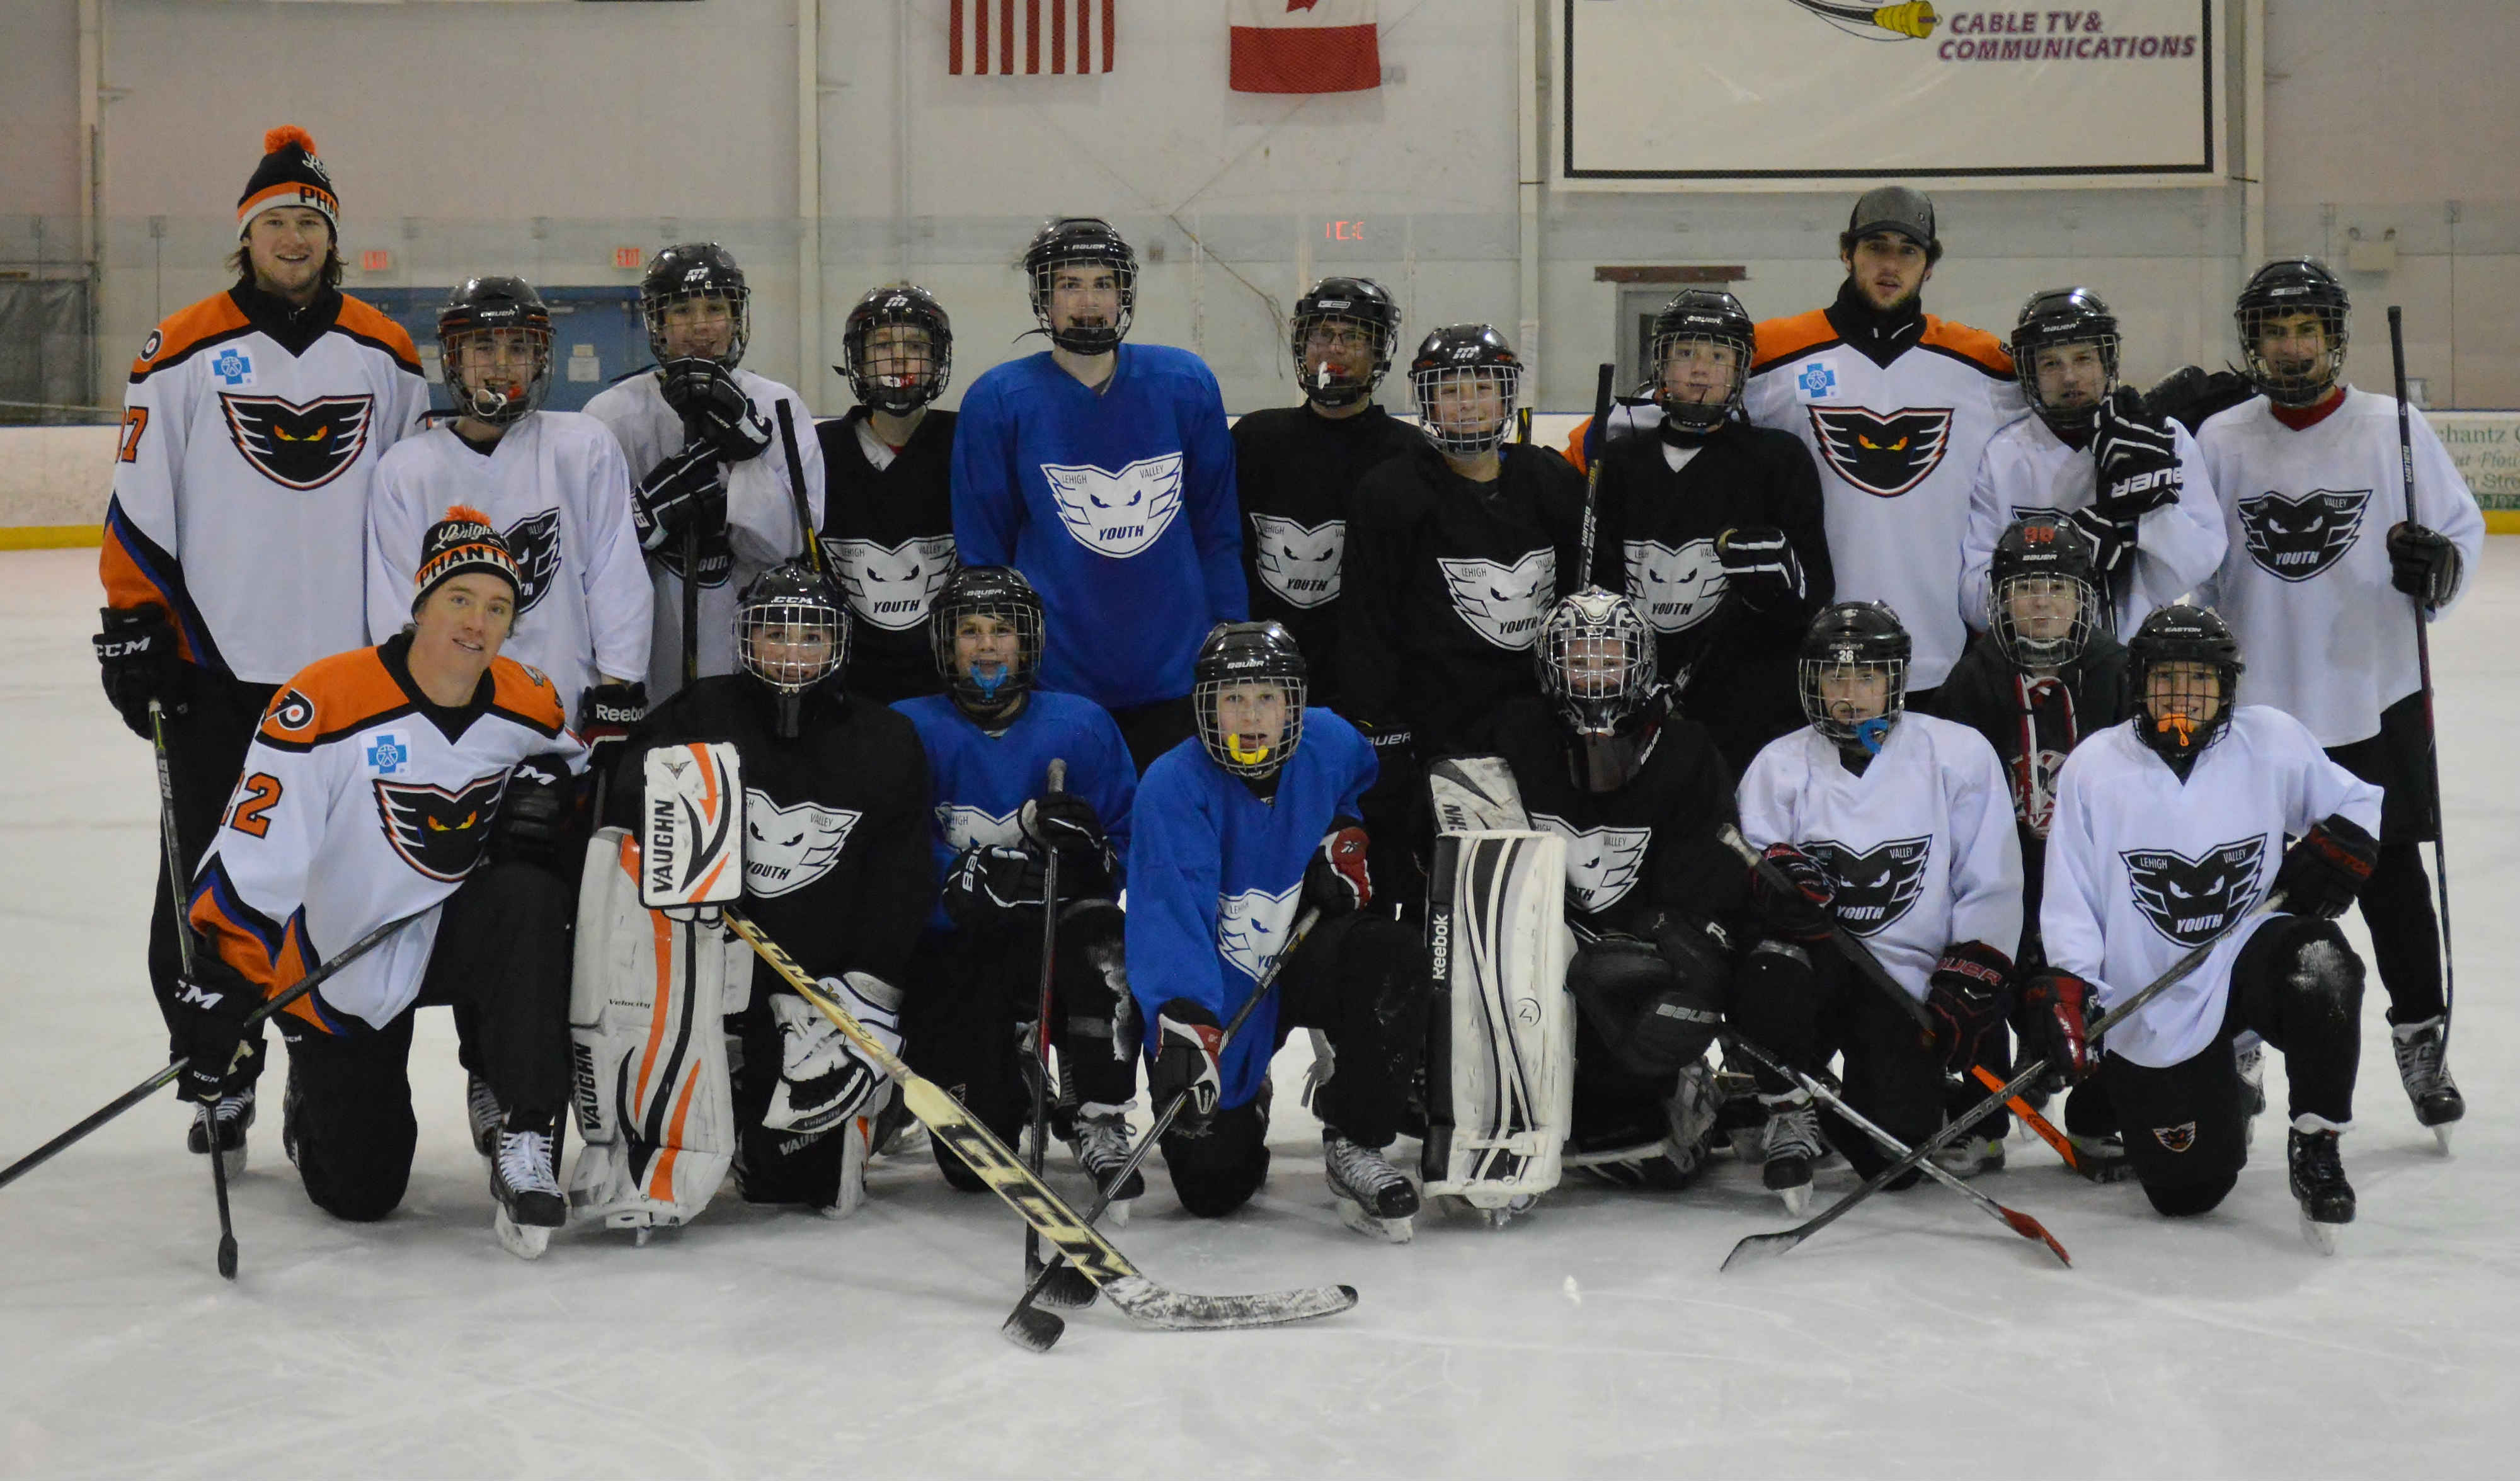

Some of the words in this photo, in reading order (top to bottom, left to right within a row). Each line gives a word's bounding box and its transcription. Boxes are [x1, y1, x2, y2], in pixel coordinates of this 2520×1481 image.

[1951, 12, 2039, 35] CABLE
[2046, 11, 2103, 33] TV&
[1939, 35, 2197, 60] COMMUNICATIONS
[115, 407, 147, 466] 7
[2436, 423, 2506, 443] chantz
[1062, 474, 1087, 484] LEHIGH
[1140, 465, 1164, 479] VALLEY
[2484, 474, 2520, 487] Stre
[2323, 496, 2349, 508] VALLEY
[1099, 525, 1144, 540] YOUTH
[1700, 547, 1716, 558] VALL
[2275, 551, 2320, 566] YOUTH
[1462, 568, 1487, 578] LEHIGH
[966, 588, 1003, 597] BAUER
[1286, 578, 1328, 592] YOUTH
[774, 596, 813, 605] CCM
[873, 598, 921, 614] YOUTH
[1651, 602, 1695, 615] YOUTH
[1499, 615, 1538, 635] YOUTH
[1838, 649, 1854, 663] 26
[1227, 660, 1264, 669] BAUER
[595, 704, 648, 723] Reebo
[1367, 731, 1412, 747] AUER
[810, 813, 833, 828] VALLEY
[951, 816, 969, 826] HIGH
[1535, 823, 1552, 832] HIGH
[1603, 836, 1627, 847] VALLEY
[652, 799, 675, 893] VAUGHN
[1889, 847, 1913, 859] VALLEY
[2139, 857, 2168, 870] LEHIGH
[2223, 849, 2247, 864] VALLEY
[1836, 905, 1886, 920] YOUTH
[2176, 913, 2225, 934] YOUTH
[1432, 914, 1448, 981] Reebok
[1937, 957, 2004, 986] AUER
[609, 998, 651, 1009] Velocity
[575, 1042, 602, 1131] VAUGHN
[778, 1131, 829, 1156] VAUG
